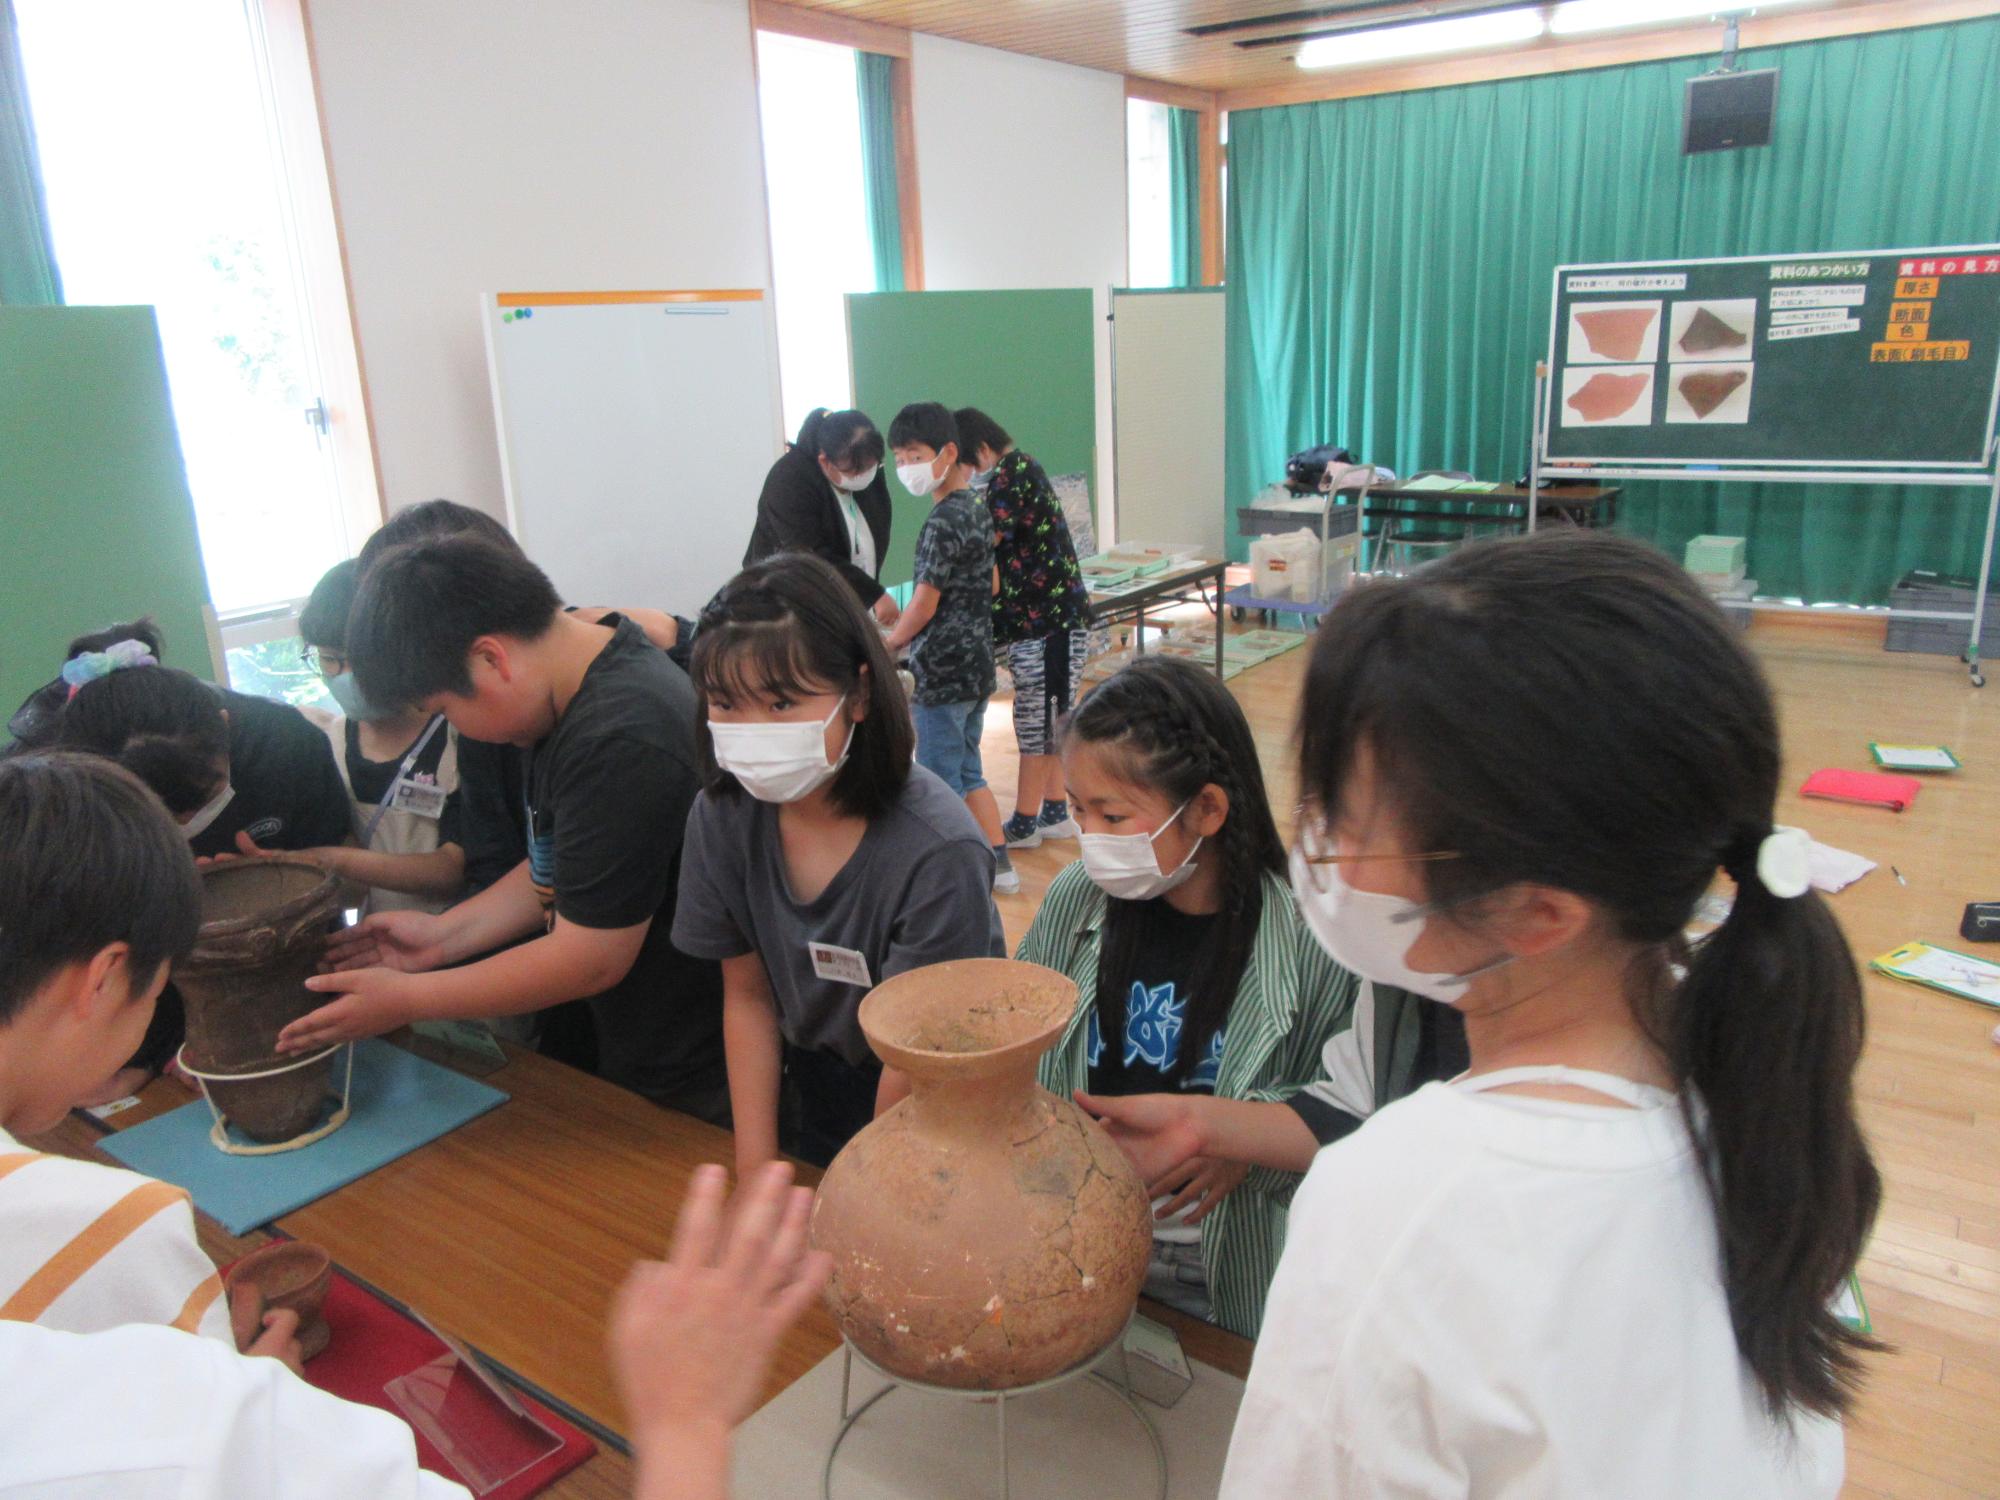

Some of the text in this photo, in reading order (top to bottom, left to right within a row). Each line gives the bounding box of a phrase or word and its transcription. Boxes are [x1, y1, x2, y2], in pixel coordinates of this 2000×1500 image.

[1770, 263, 1870, 279] 資料のあつかい方
[1900, 259, 1999, 276] 資料の見方
[1902, 281, 1931, 294] 厚さ
[1895, 308, 1926, 321] 断面
[1900, 324, 1914, 338] 色
